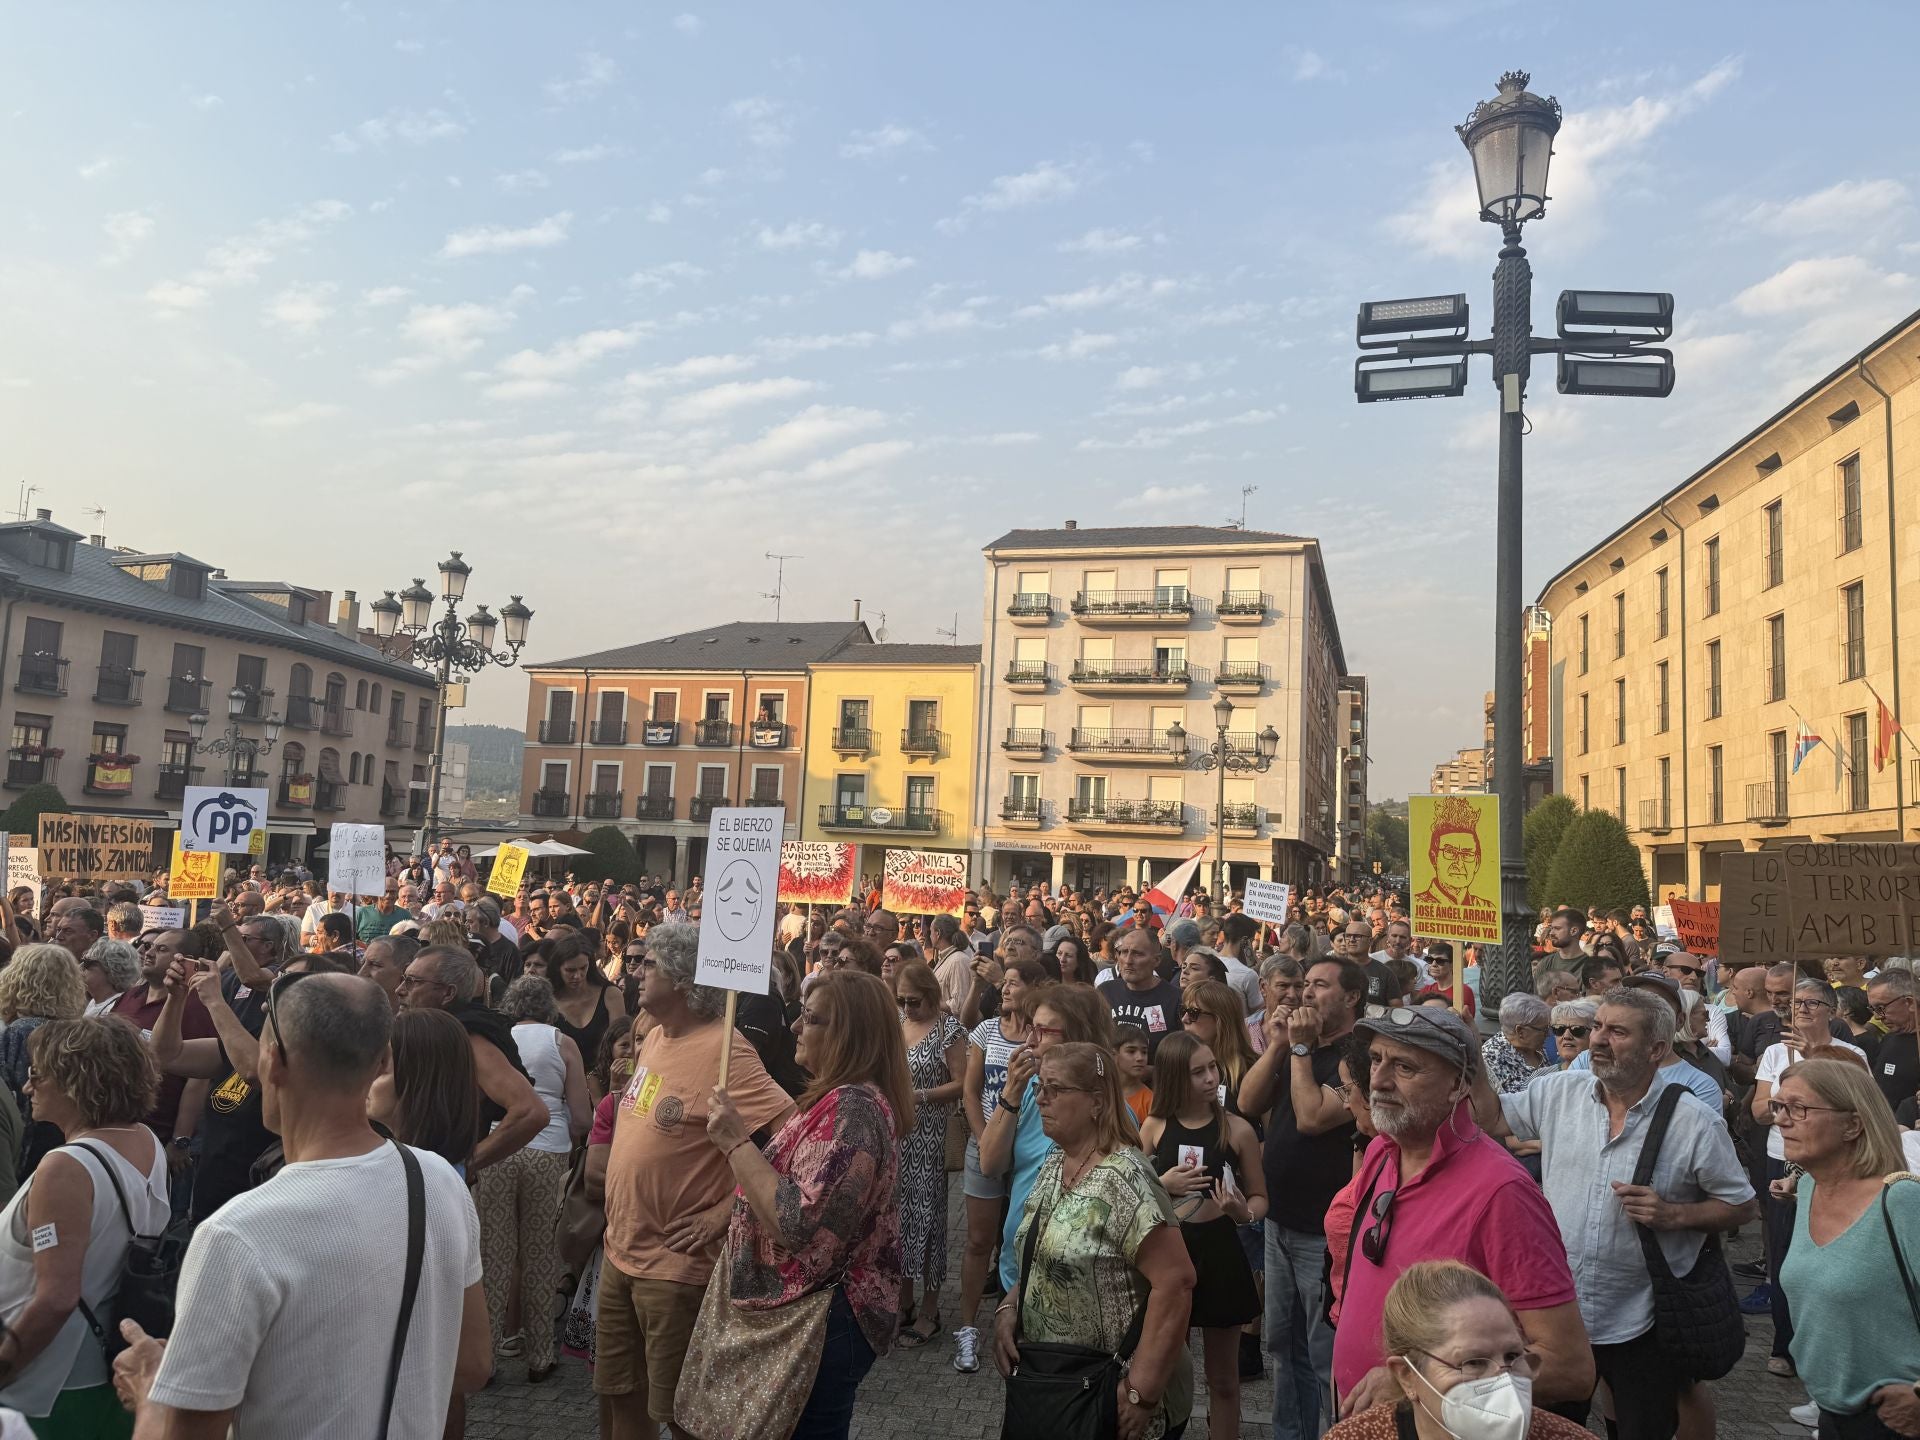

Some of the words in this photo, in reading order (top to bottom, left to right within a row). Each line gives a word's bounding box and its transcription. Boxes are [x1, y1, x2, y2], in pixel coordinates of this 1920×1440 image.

[719, 817, 731, 832] EL
[733, 817, 773, 833] BIERZO
[716, 837, 730, 851] SE
[733, 838, 772, 853] QUEMA
[1040, 841, 1093, 852] HONTANAR
[44, 848, 54, 872] Y
[59, 847, 102, 873] MENOS
[1786, 842, 1898, 868] GOBIERNO
[953, 855, 965, 874] 3
[1248, 889, 1257, 897] EN
[1258, 891, 1284, 902] INVIERNO
[1248, 899, 1257, 907] EN
[1258, 901, 1282, 912] VERANO
[1415, 903, 1435, 918] JOSÉ
[1436, 903, 1462, 920] ÁNGEL
[1463, 907, 1497, 923] ARRANZ
[1255, 910, 1282, 921] INFIERNO
[1415, 922, 1480, 937] ¡DESTITUCIÓN
[1482, 926, 1498, 940] YA!
[1678, 918, 1695, 931] NO
